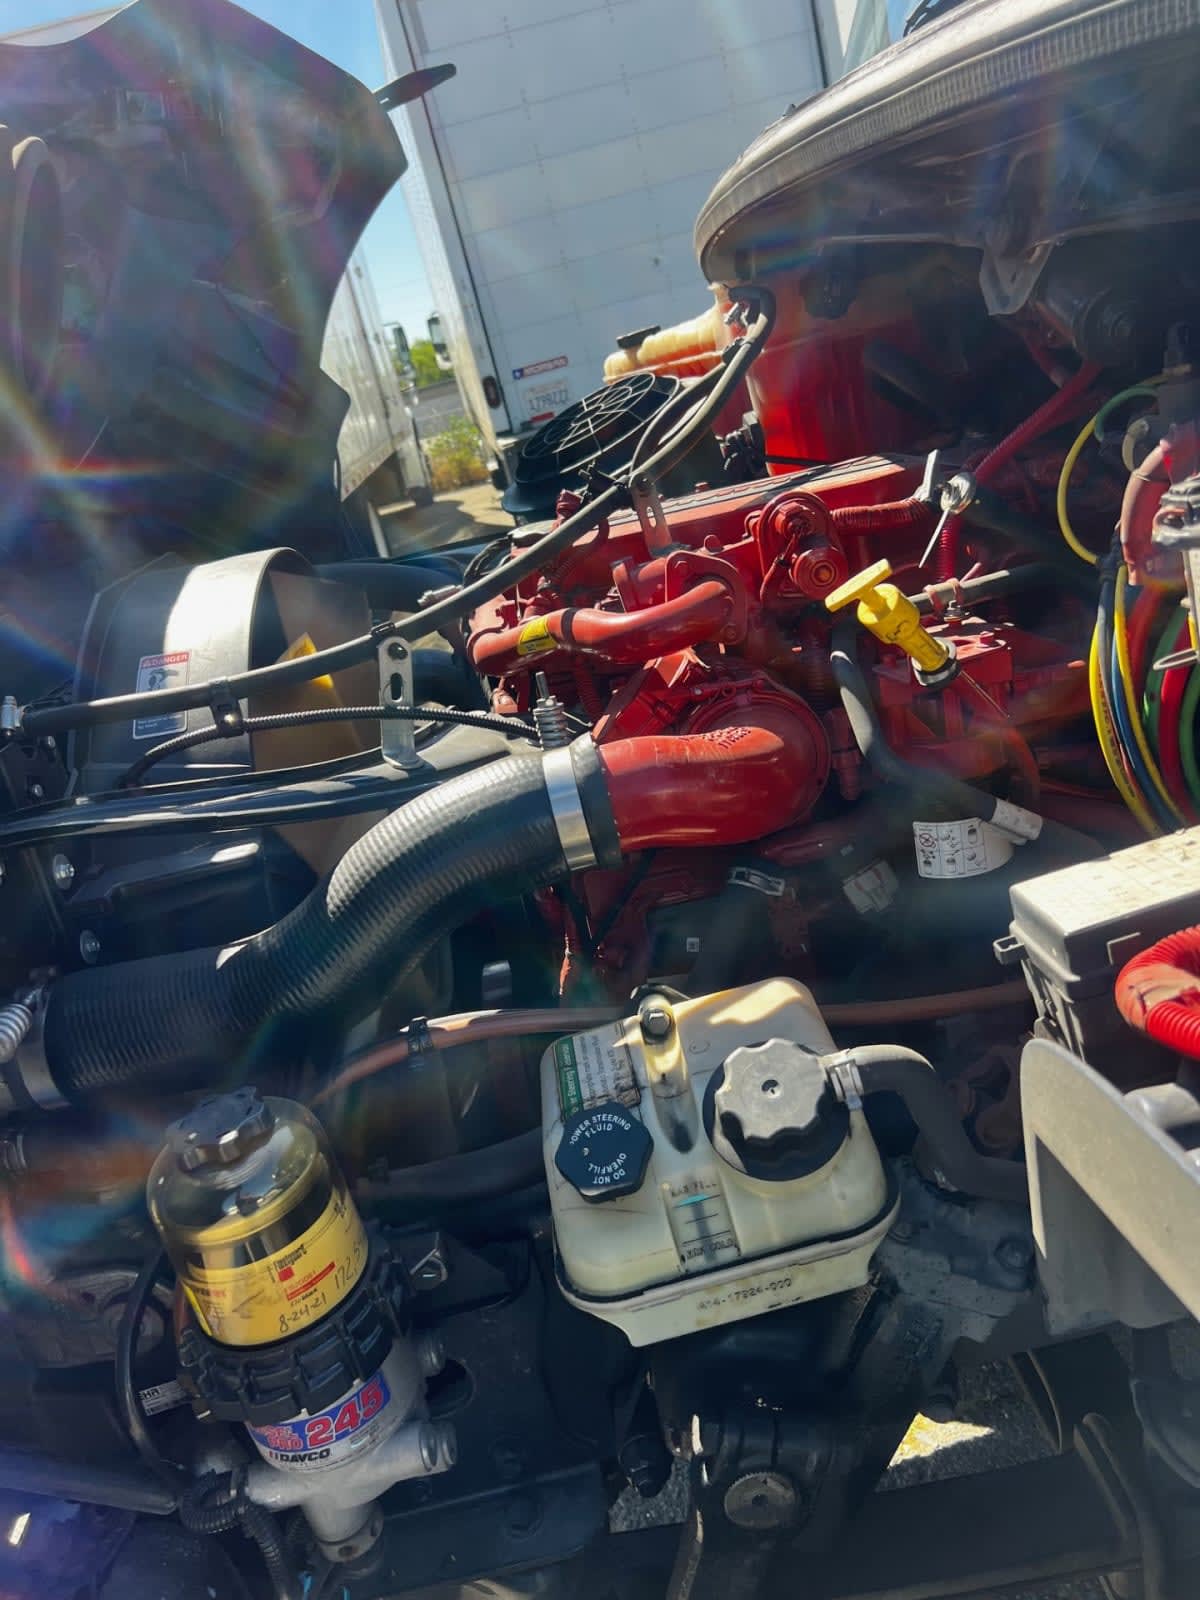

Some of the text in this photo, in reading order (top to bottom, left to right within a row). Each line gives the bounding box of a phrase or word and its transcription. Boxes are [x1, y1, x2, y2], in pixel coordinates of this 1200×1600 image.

[151, 653, 188, 666] DANGER
[584, 1123, 613, 1138] FLUID
[591, 1113, 632, 1131] STEERING
[587, 1152, 627, 1174] OVERFILL
[592, 1168, 626, 1184] DO NOT
[279, 1292, 327, 1334] 8-24-21
[305, 1380, 383, 1449] 245
